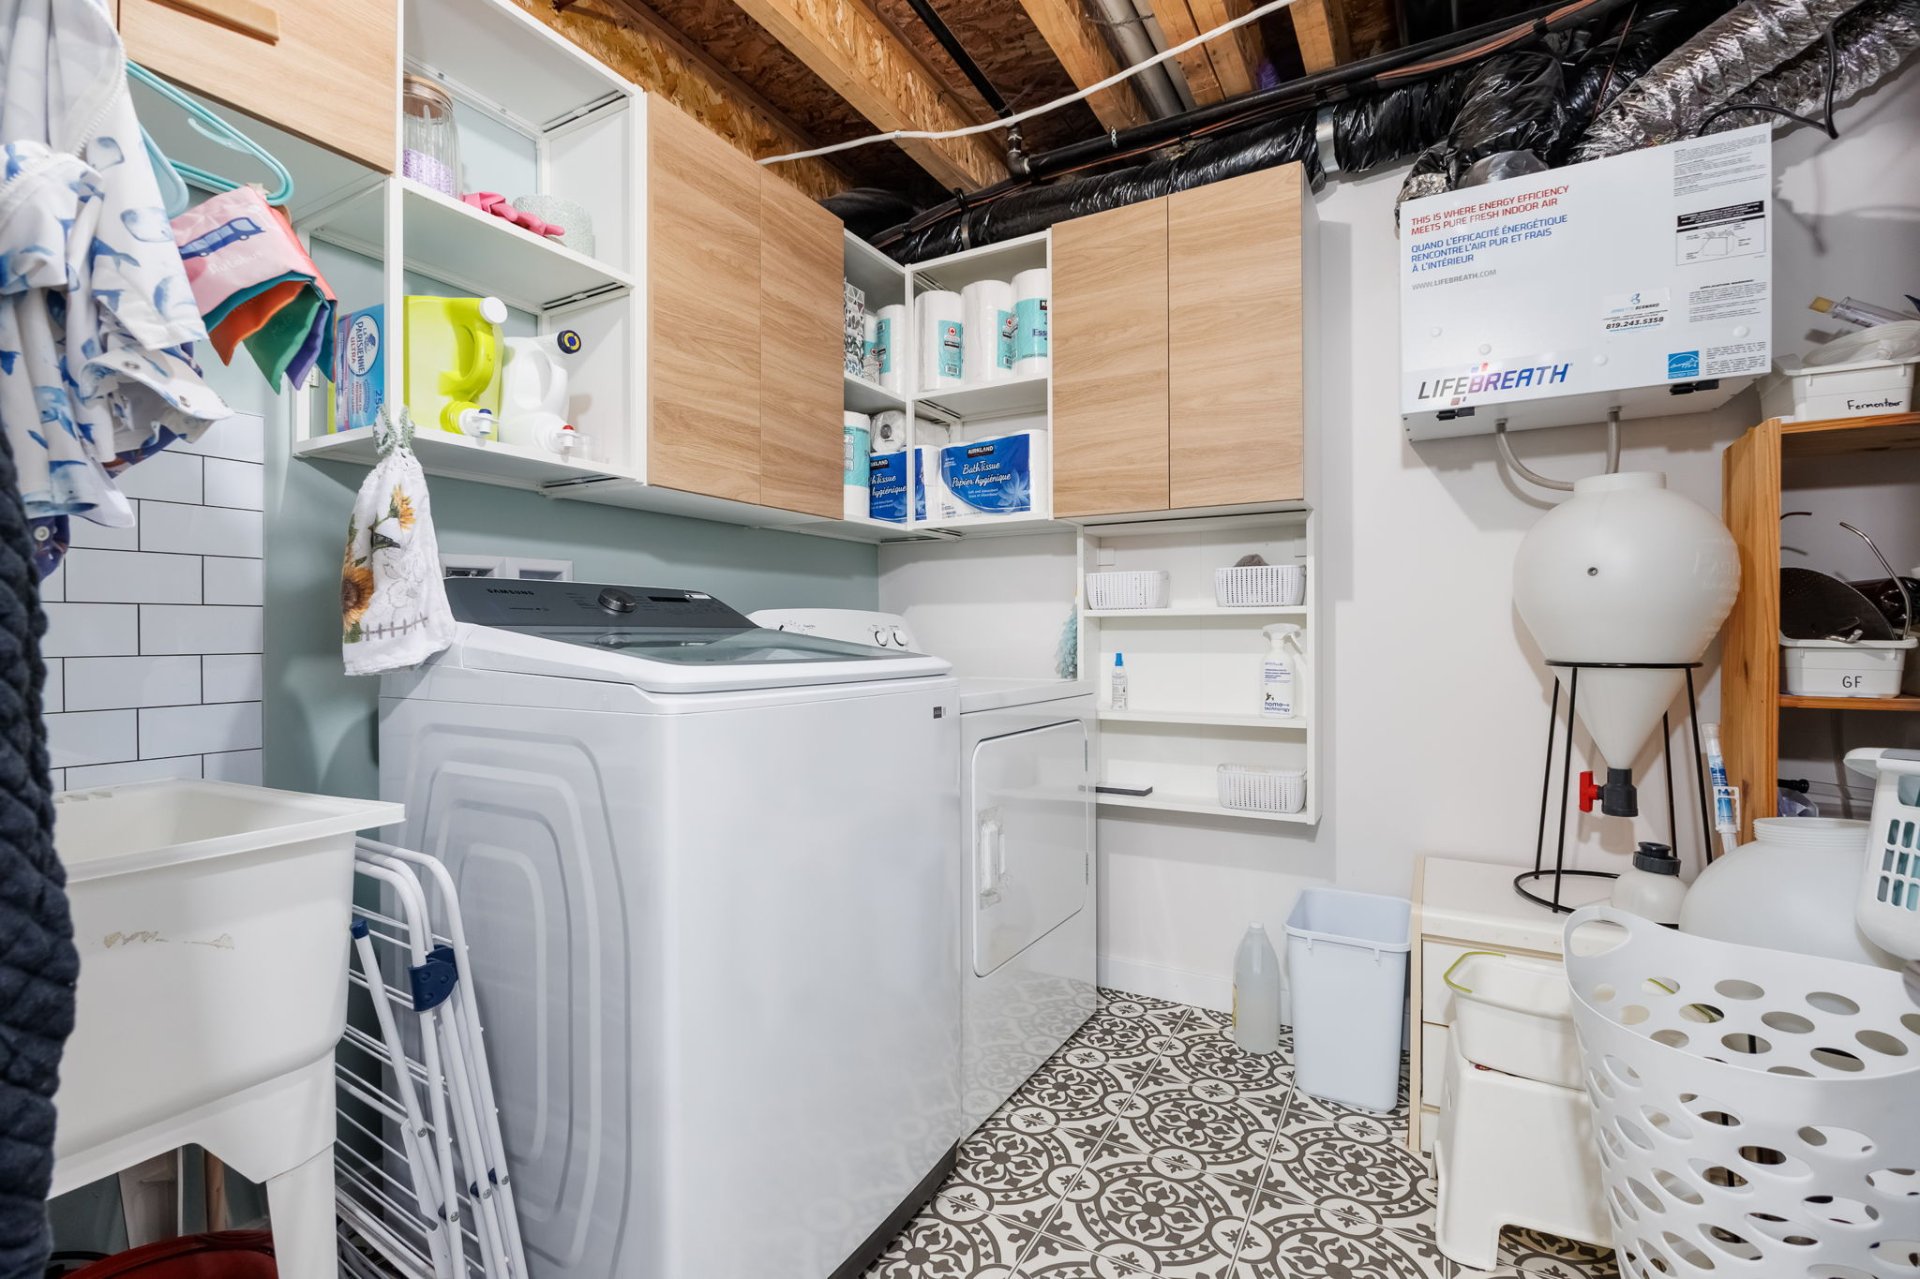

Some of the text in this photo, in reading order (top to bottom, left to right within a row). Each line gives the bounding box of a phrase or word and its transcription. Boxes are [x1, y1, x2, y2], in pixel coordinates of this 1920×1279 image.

[1411, 185, 1569, 226] THIS IS WHERE ENERGY EFFICIENCY
[1411, 198, 1558, 236] MEETS PURE FRESH INDOOR AIR
[1411, 214, 1568, 253] QUAND L'EFFICACITÉ ÉNERGÉTIQUE
[1411, 228, 1552, 263] RENCONTRE L'AIR PUR ET FRAIS
[1411, 253, 1474, 273] À L'INTÉRIEUR
[1412, 269, 1497, 290] WWW.LIFEBREATH.COM
[1605, 316, 1665, 330] 819.243.5358
[356, 321, 365, 373] PARISIENNE
[1418, 363, 1570, 400] LIFEBREATH
[968, 445, 994, 455] KIRKLAND
[962, 462, 980, 474] Bath
[980, 460, 1001, 472] Tissue
[877, 474, 896, 484] Tissue
[952, 473, 1011, 488] Papier hygiénique
[487, 588, 535, 596] SAMSUNG
[1842, 675, 1862, 689] GF
